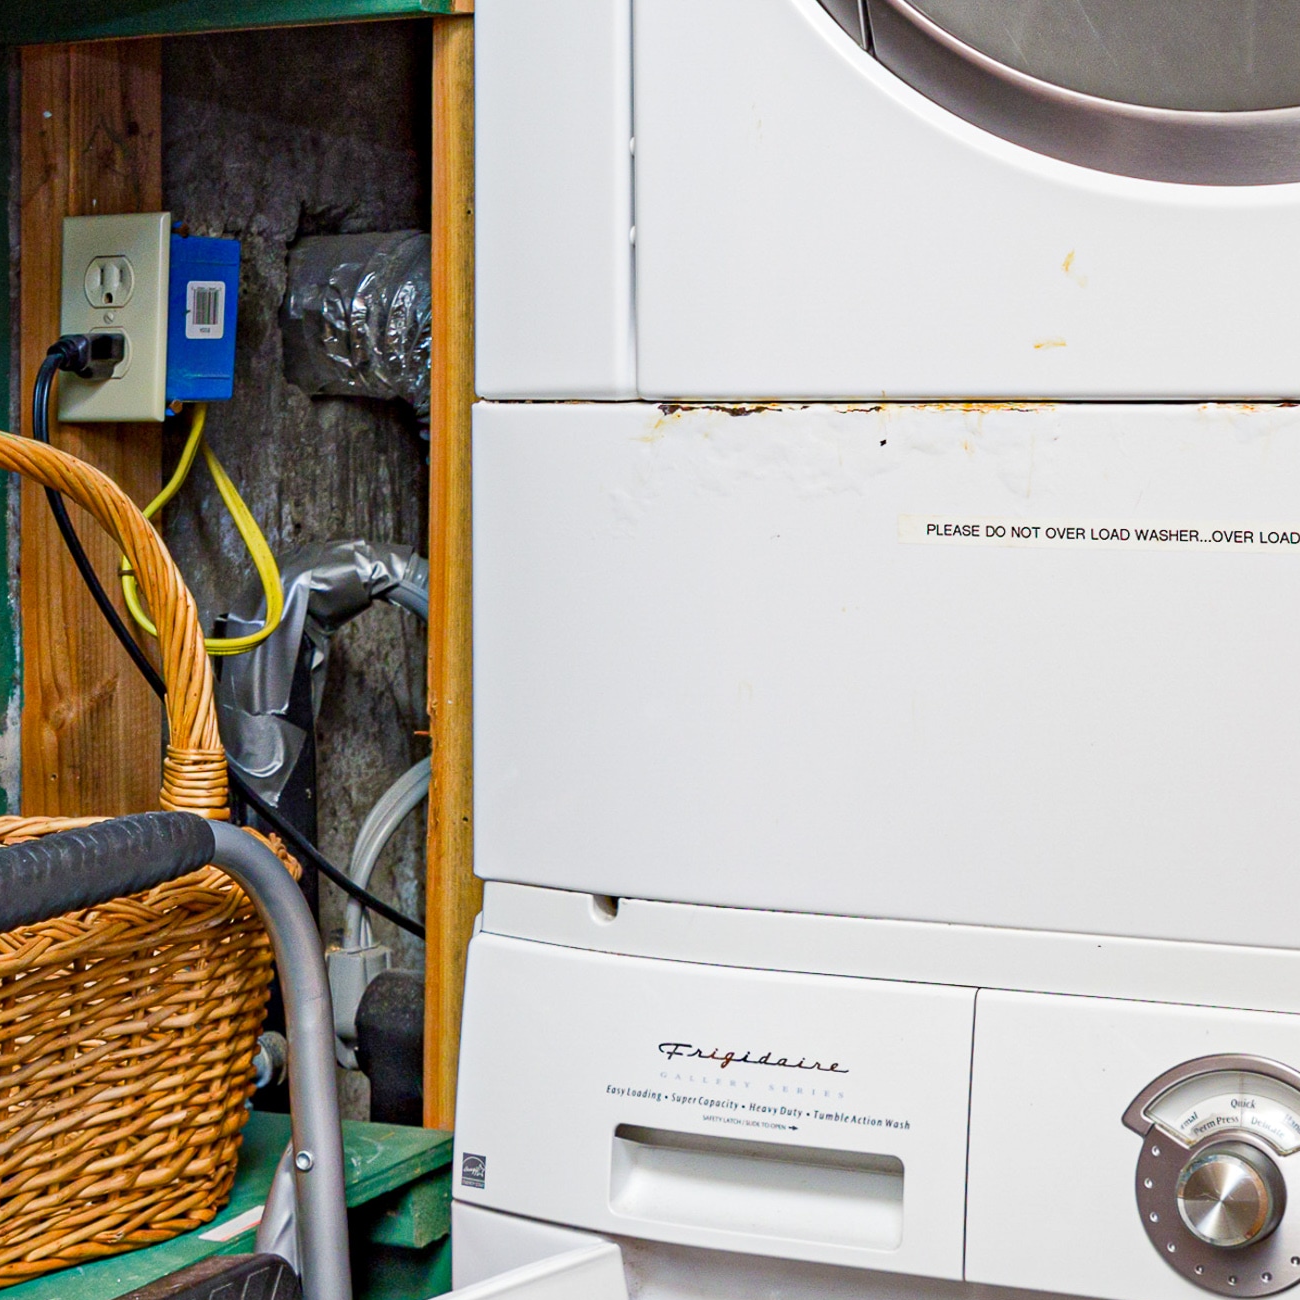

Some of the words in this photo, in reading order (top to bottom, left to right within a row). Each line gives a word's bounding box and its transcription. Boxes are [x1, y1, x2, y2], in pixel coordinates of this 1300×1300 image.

[926, 523, 981, 537] PLEASE
[985, 525, 1007, 538] DO
[1011, 526, 1042, 539] NOT
[1045, 527, 1086, 540] OVER
[1090, 528, 1131, 541] LOAD
[658, 1042, 850, 1074] Frigidaire
[660, 1070, 751, 1089] GALLERY
[768, 1084, 845, 1100] SERIES
[606, 1084, 626, 1097] Easy
[626, 1087, 662, 1102] Loading
[671, 1092, 697, 1105] Super
[698, 1096, 739, 1111] Capacity
[749, 1103, 778, 1116] Heavy
[779, 1106, 803, 1119] Duty
[813, 1110, 850, 1124] Tumble
[850, 1115, 883, 1127] Action
[885, 1119, 911, 1130] Wash
[1230, 1098, 1257, 1110] Quick
[1192, 1119, 1216, 1136] Perm
[1216, 1115, 1240, 1126] Press
